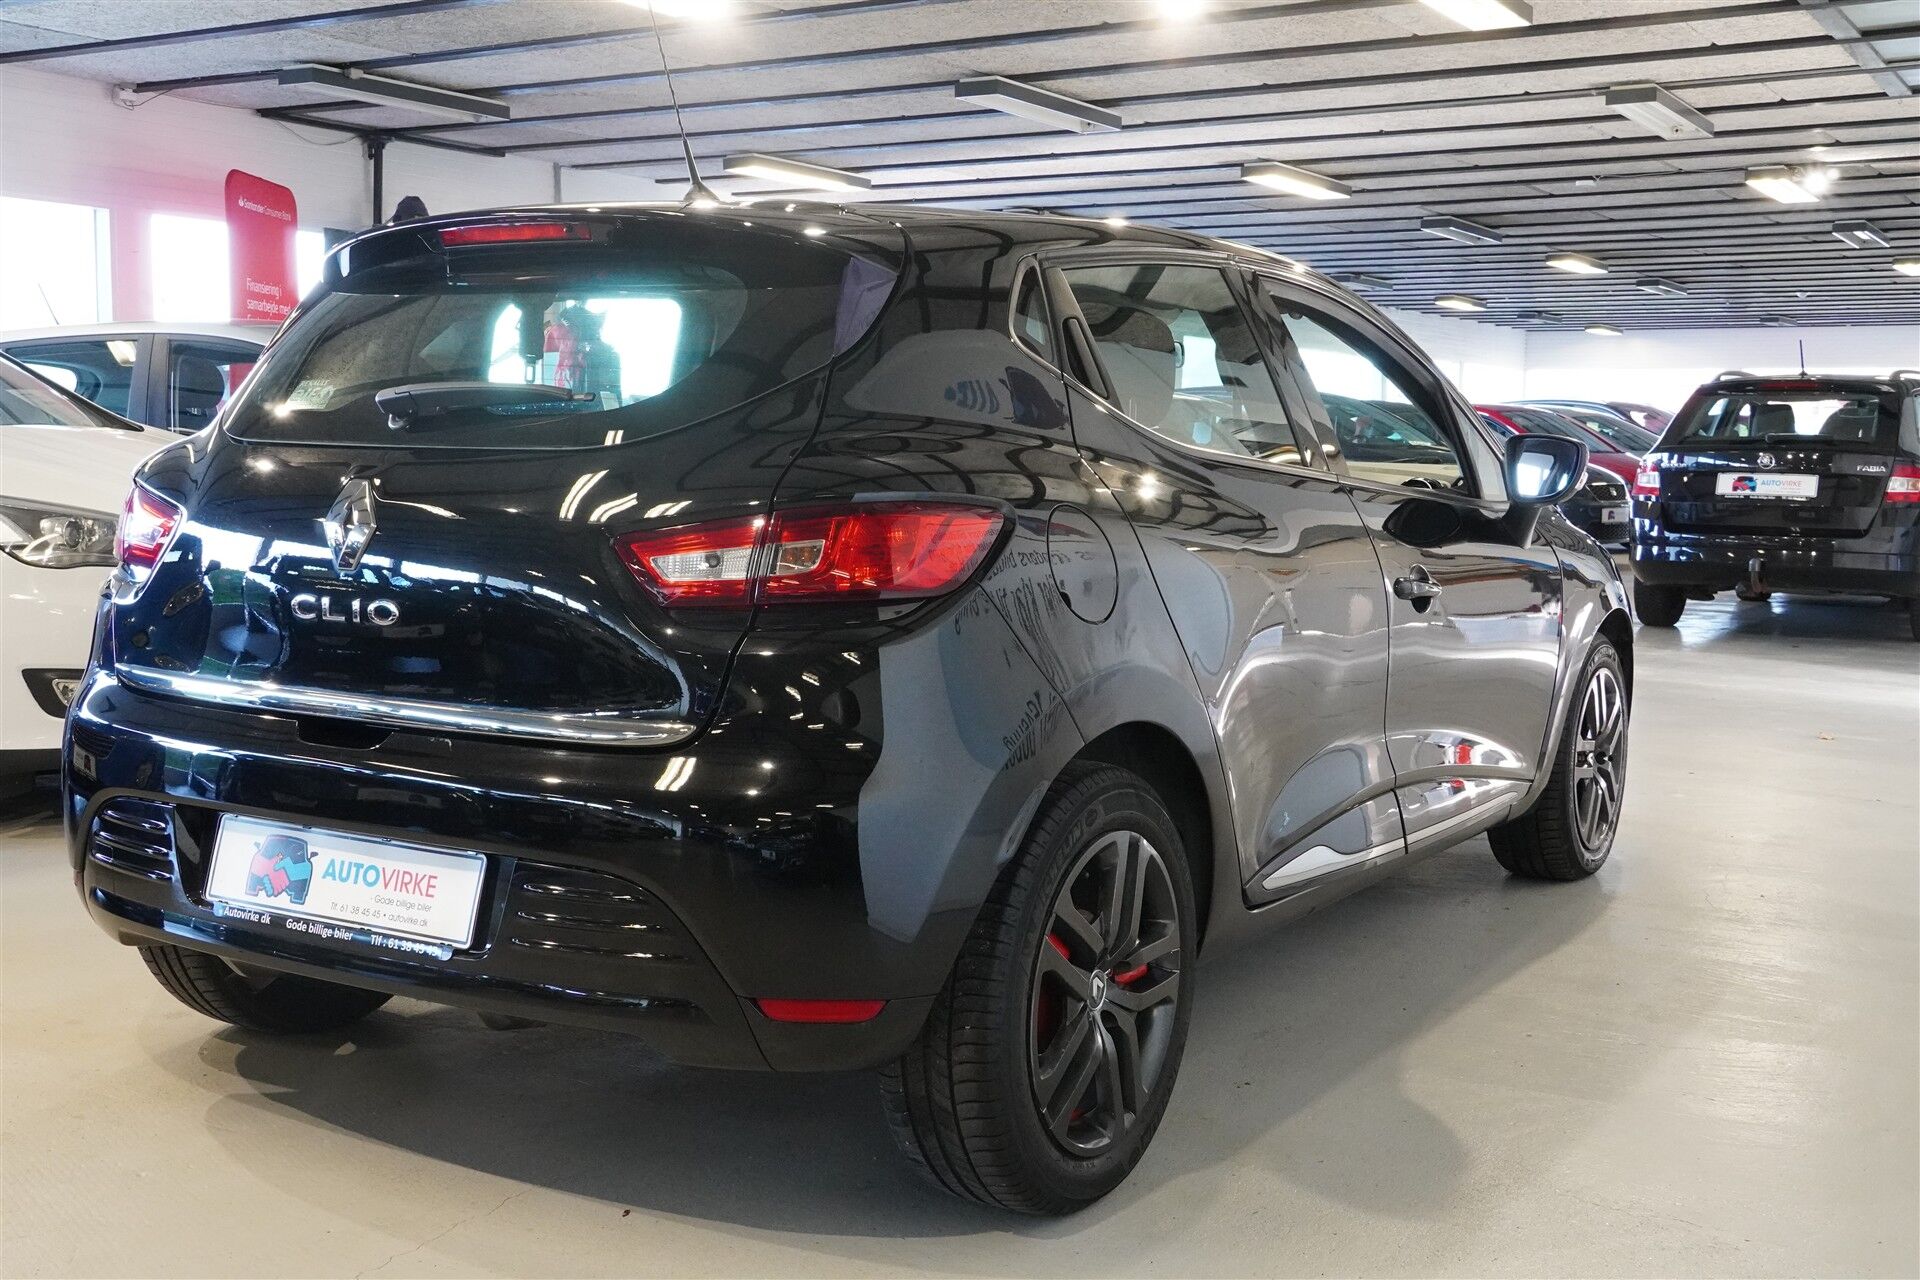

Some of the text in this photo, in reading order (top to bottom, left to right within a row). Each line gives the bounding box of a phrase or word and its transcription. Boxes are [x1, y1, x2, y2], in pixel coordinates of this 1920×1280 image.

[246, 277, 279, 299] Finansiering
[246, 299, 278, 316] samarbejde
[1760, 479, 1802, 488] AUTOVIRKE
[290, 593, 399, 626] CLIO
[321, 857, 438, 899] AUTOVIRKE
[339, 903, 349, 912] 61
[350, 905, 360, 915] 38
[361, 907, 370, 917] 45
[371, 909, 381, 919] 45
[374, 894, 432, 913] Gode billige biler
[285, 918, 307, 932] Gode
[308, 922, 333, 939] billige
[333, 927, 354, 941] biler
[388, 938, 399, 950] 61
[400, 940, 412, 952] 38
